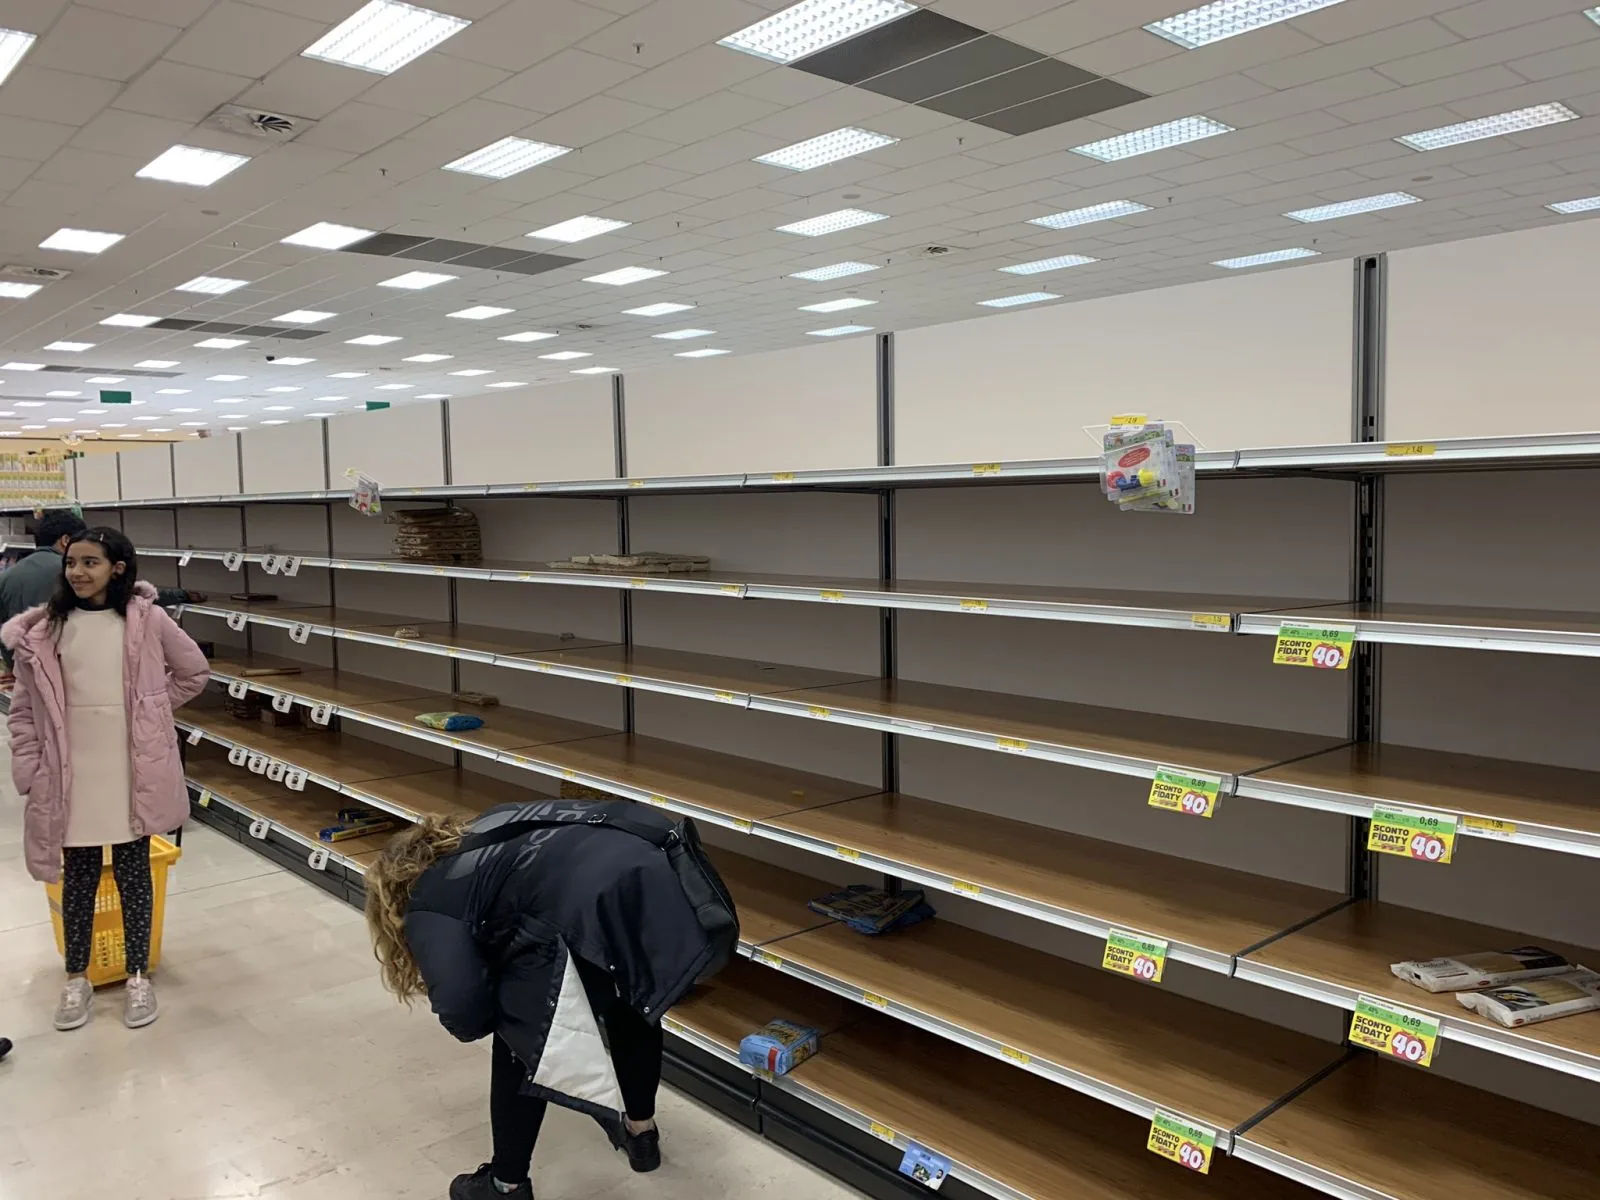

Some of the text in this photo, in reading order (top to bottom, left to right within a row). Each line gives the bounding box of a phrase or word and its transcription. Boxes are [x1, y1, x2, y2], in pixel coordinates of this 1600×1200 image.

[1322, 630, 1339, 638] 0,69
[1280, 640, 1312, 648] SCONTO
[1154, 783, 1183, 794] SCONTO
[1191, 778, 1207, 788] 0,69
[1420, 816, 1438, 826] 0,69
[1373, 824, 1410, 836] SCONTO
[1108, 946, 1134, 957] SCONTO
[1356, 1015, 1392, 1033] SCONTO
[1402, 1015, 1422, 1027] 0,69
[1152, 1127, 1180, 1142] SCONTO
